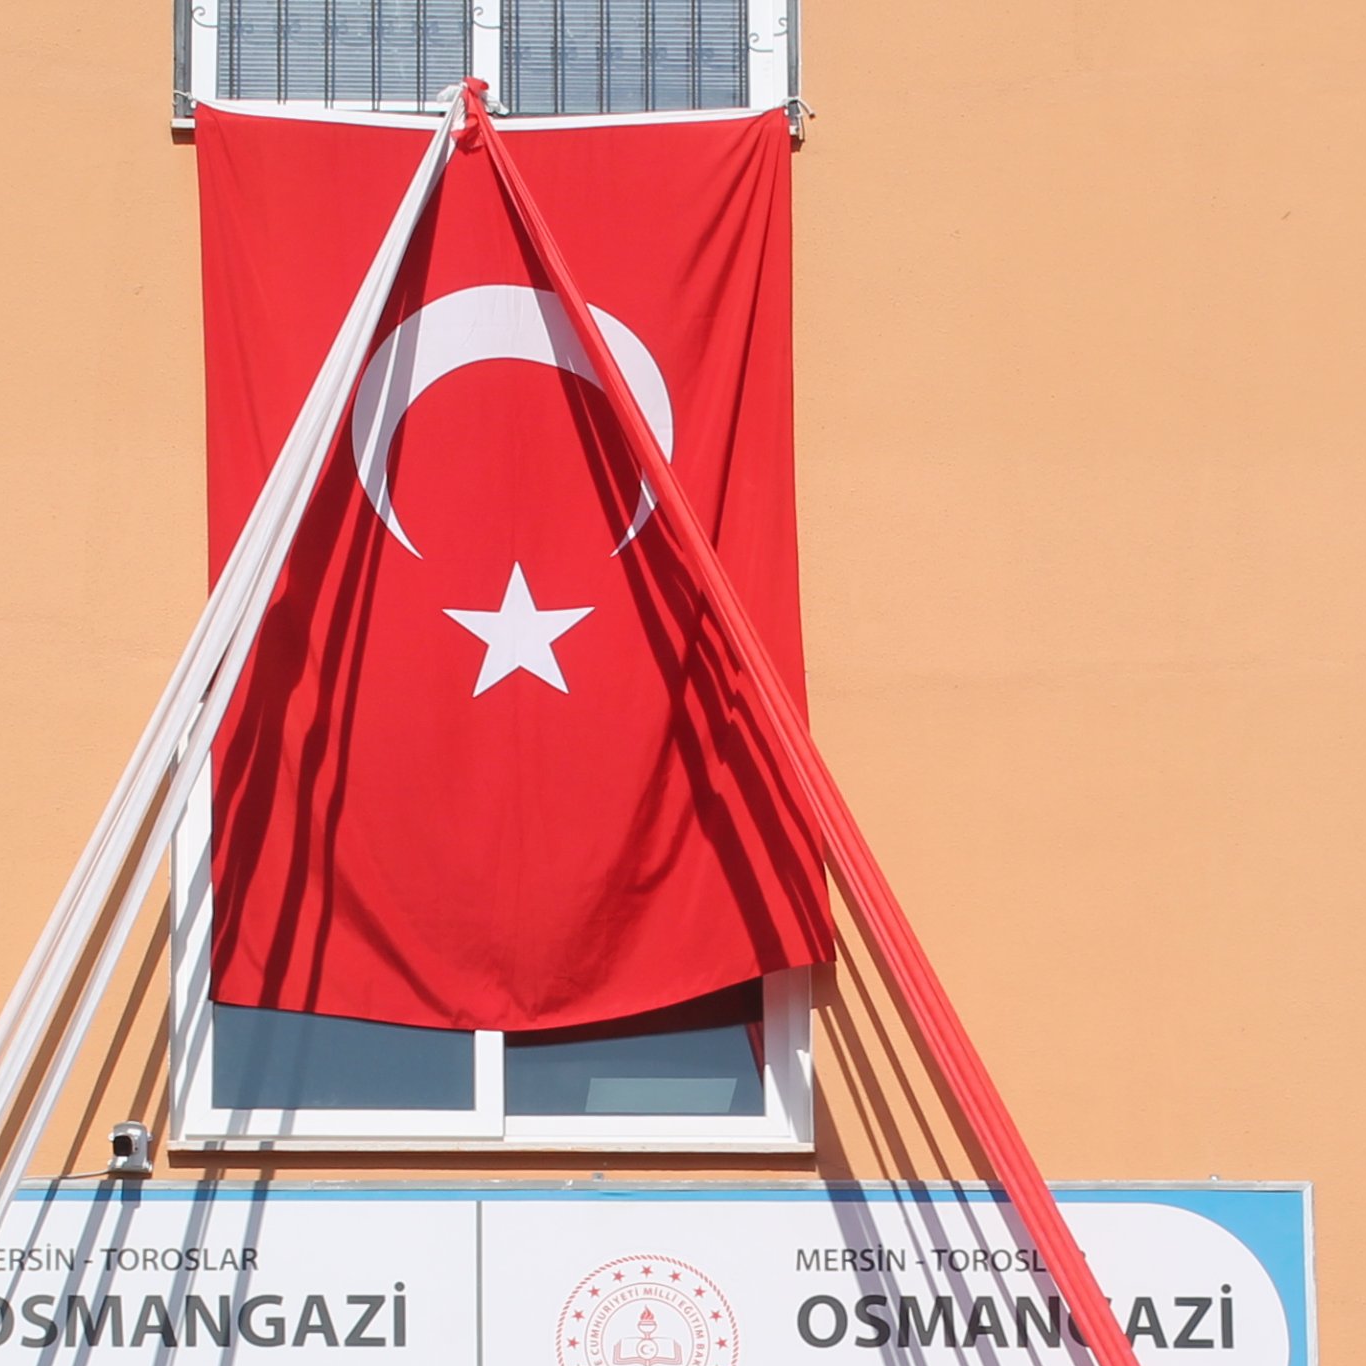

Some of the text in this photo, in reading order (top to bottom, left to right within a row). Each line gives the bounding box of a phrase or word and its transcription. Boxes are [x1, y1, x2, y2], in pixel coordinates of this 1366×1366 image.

[100, 1248, 259, 1271] TOROSLAR
[796, 1243, 906, 1272] MERSİN
[931, 1248, 1086, 1272] TOROSL
[589, 1286, 639, 1356] CUMHURİYETİ
[643, 1286, 677, 1303] MİLLİ
[678, 1299, 705, 1340] EĞİTİM
